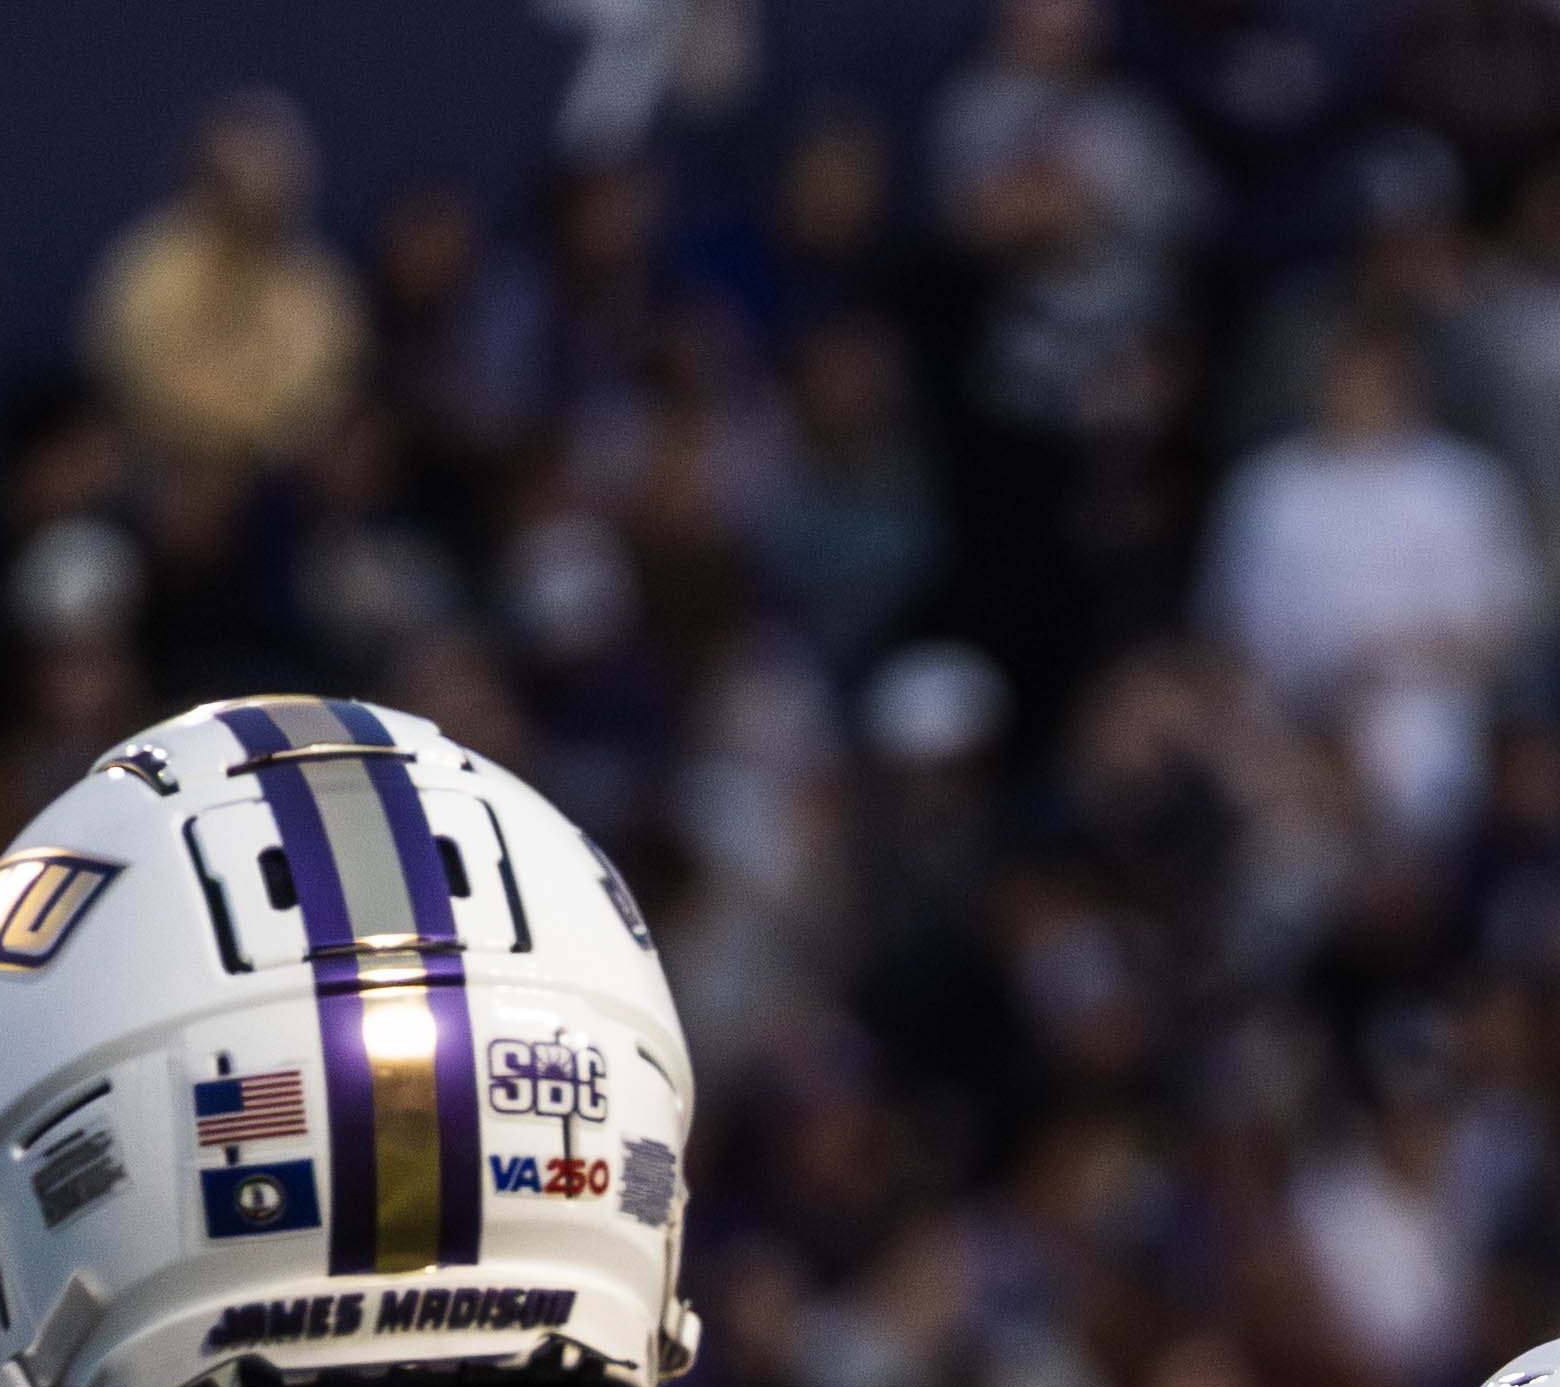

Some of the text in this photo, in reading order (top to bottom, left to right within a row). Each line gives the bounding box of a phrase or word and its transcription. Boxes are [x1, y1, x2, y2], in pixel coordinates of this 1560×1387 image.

[488, 1039, 607, 1122] SBC
[201, 1287, 578, 1356] JAMES MADISON
